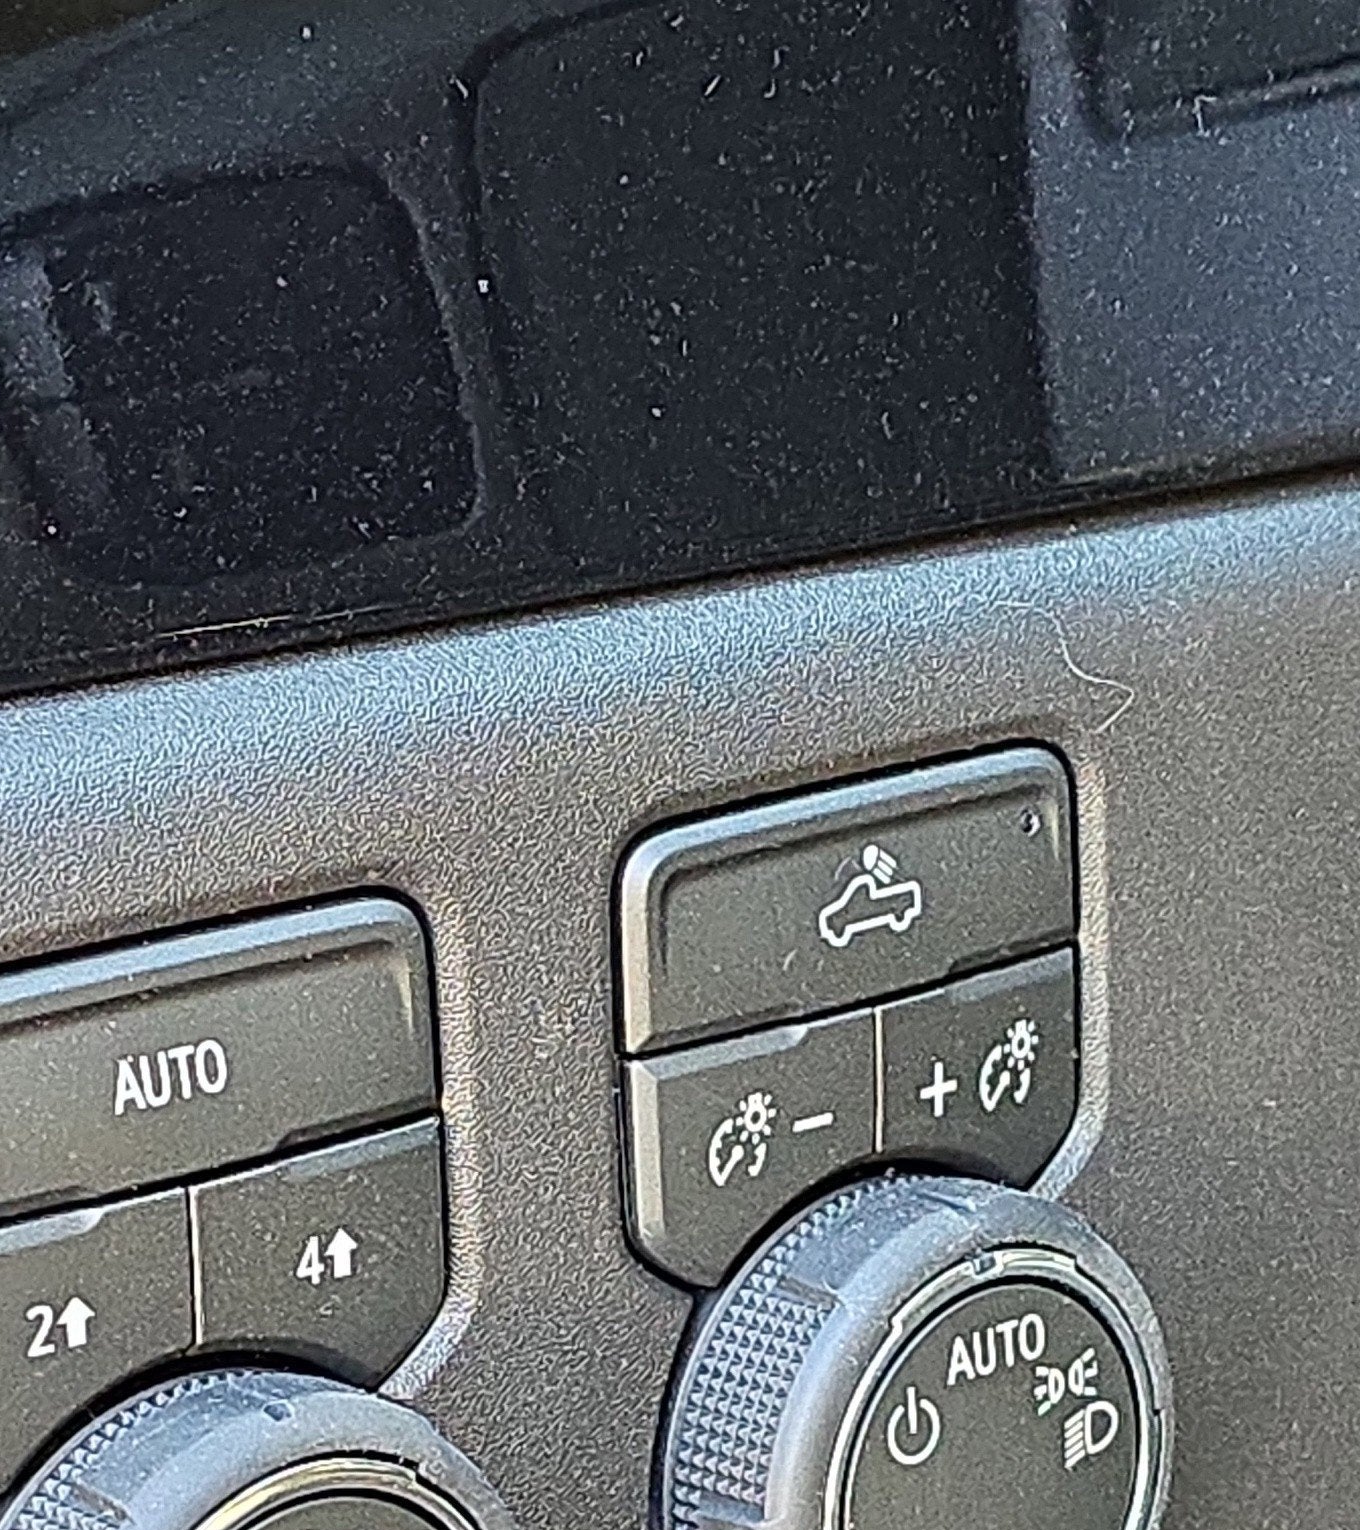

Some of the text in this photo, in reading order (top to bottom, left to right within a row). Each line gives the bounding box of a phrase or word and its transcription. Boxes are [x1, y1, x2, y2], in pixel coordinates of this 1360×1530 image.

[114, 1039, 228, 1115] AUTO
[295, 1235, 325, 1285] 4
[25, 1304, 56, 1358] 2
[946, 1313, 1046, 1387] AUTO
